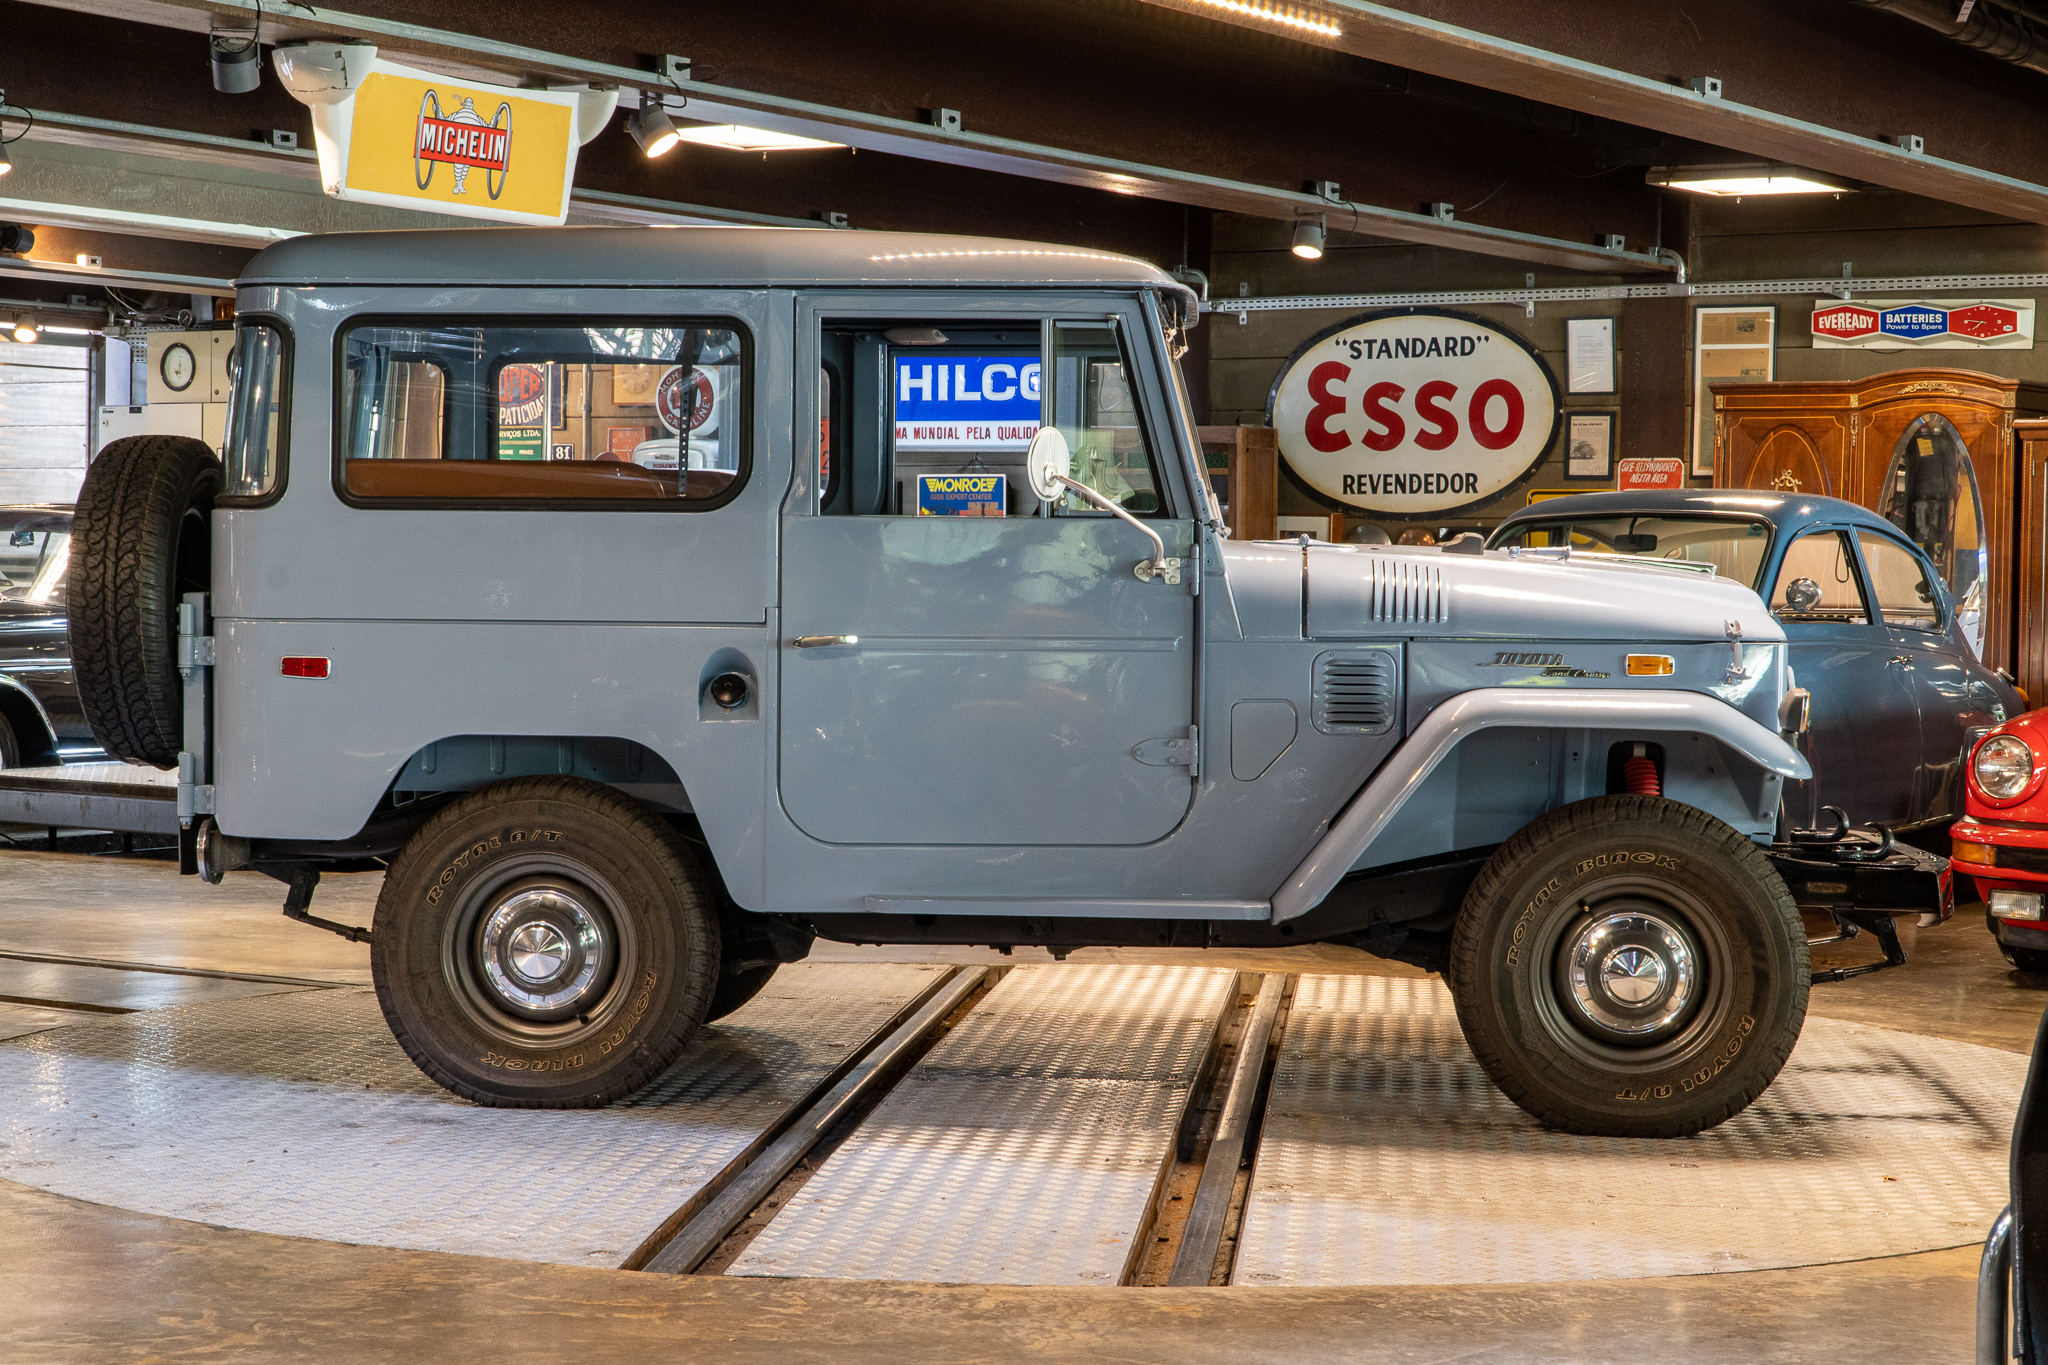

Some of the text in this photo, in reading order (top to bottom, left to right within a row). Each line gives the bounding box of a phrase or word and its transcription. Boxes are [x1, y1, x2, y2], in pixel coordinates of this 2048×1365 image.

[421, 123, 506, 163] MICHELIN
[1818, 312, 1874, 329] EVEREADY
[1886, 314, 1943, 323] BATTERIES
[666, 402, 710, 427] GALINE
[523, 429, 541, 437] LTDA.
[913, 426, 960, 440] MUNDIAL
[966, 426, 991, 440] PELA
[931, 478, 990, 492] MONROE
[1343, 472, 1479, 495] REVENDEDOR
[1629, 474, 1652, 484] NESTA
[1495, 652, 1564, 666] TOYOTA
[426, 829, 564, 907] ROYAL A/T
[1506, 852, 1681, 967] ROYAL BLACK
[480, 971, 657, 1071] ROYAL BLACK
[1681, 1014, 1755, 1092] ROYAL
